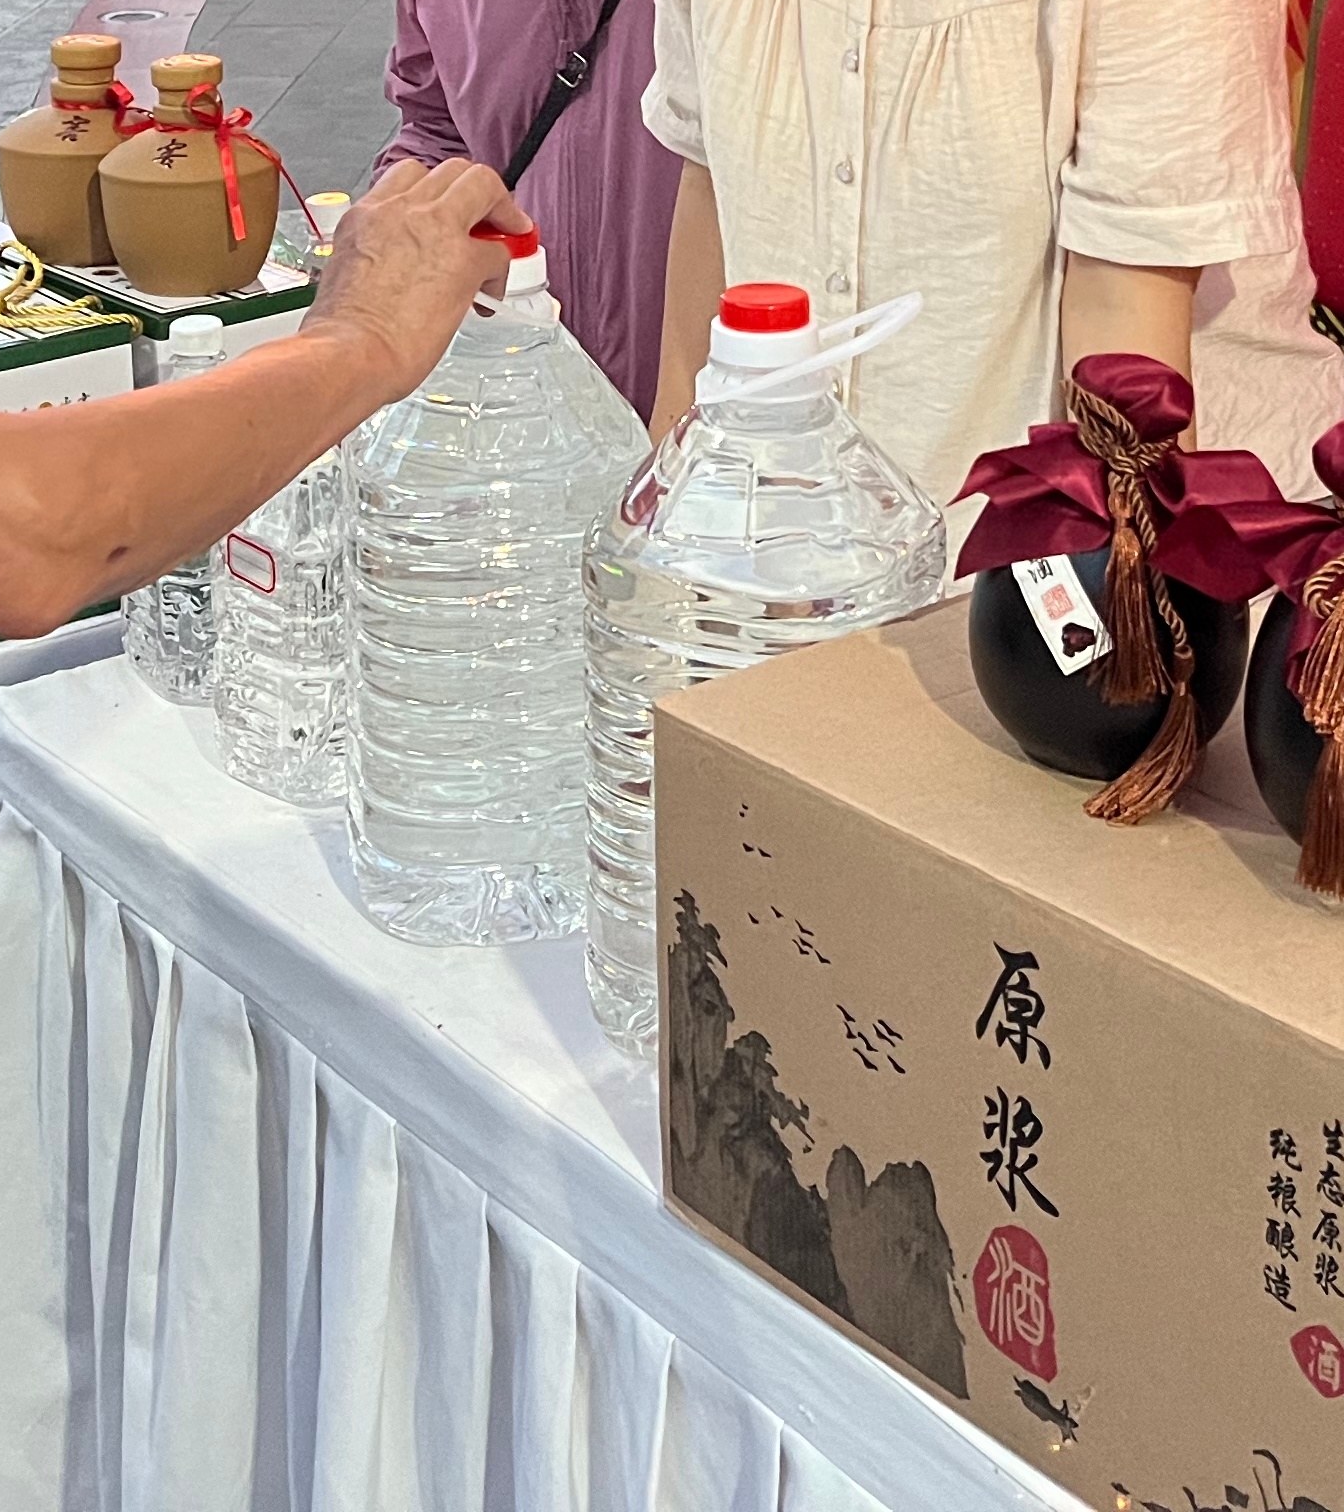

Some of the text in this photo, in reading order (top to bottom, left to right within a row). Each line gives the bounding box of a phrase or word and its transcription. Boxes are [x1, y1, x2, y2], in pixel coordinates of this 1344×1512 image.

[1262, 1126, 1303, 1313] 纯粮酿造
[1306, 1332, 1342, 1392] 酒
